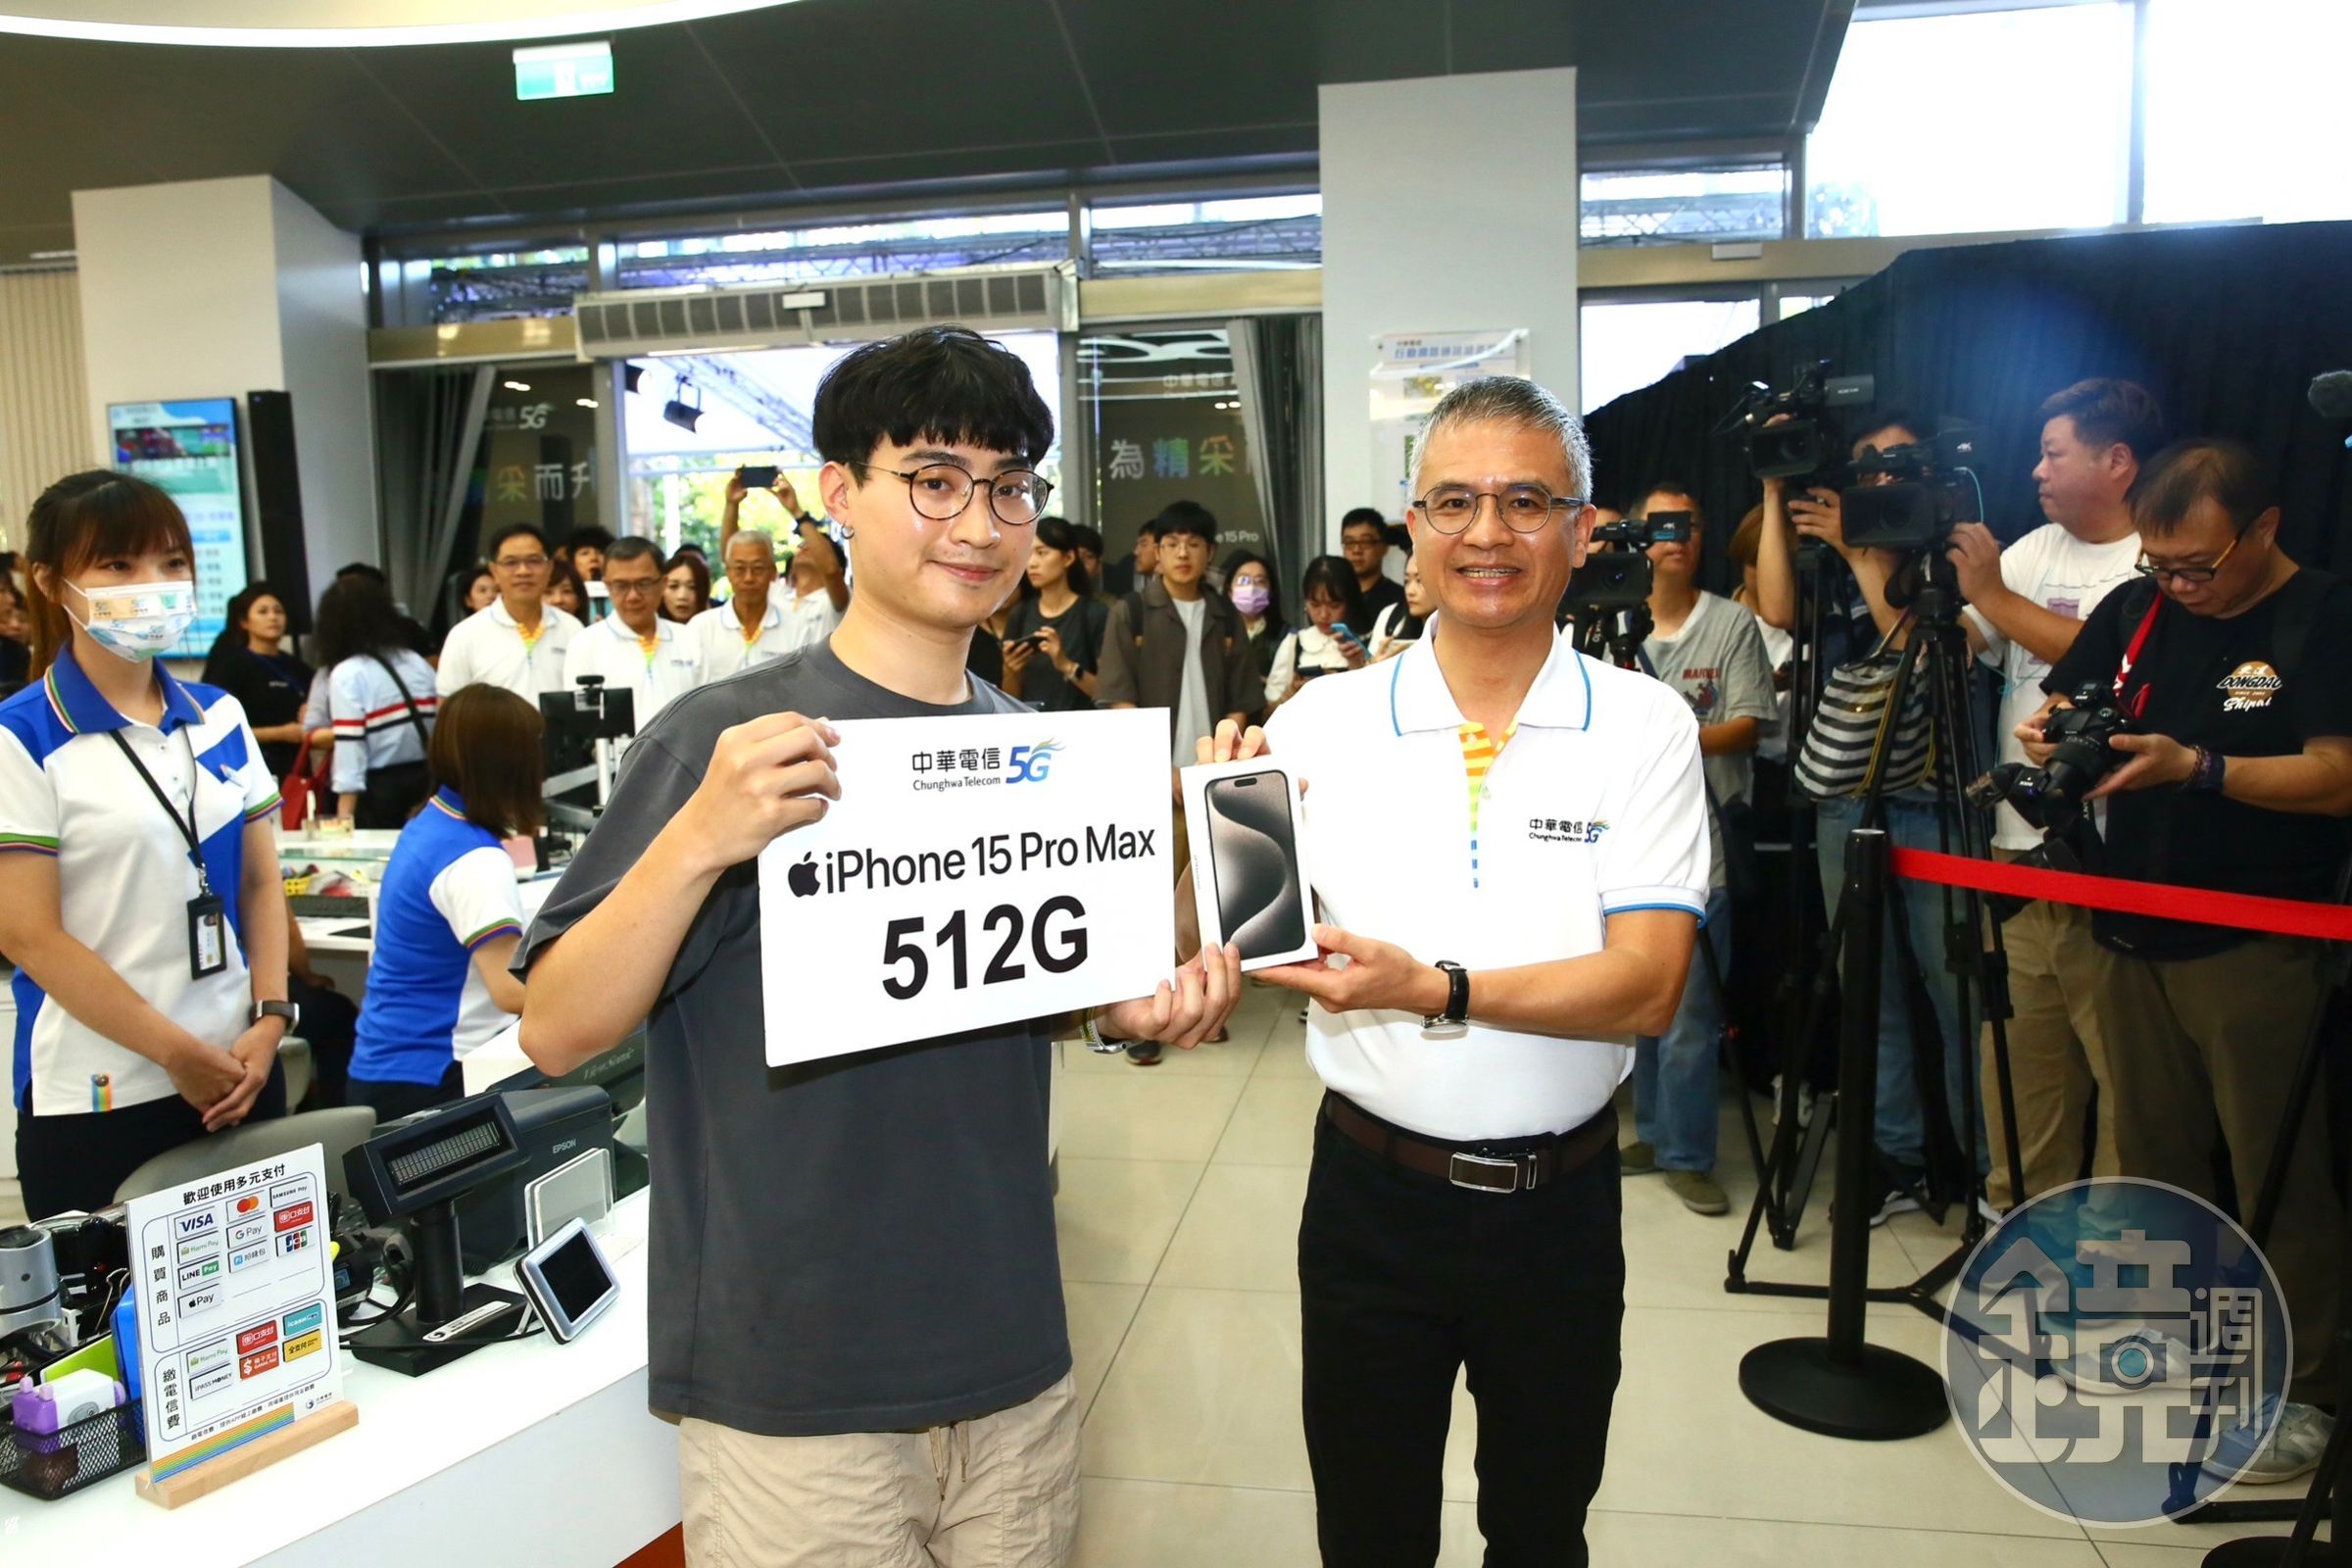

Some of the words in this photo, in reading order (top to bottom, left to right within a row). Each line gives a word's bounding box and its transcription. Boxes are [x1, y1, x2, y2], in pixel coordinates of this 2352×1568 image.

[1109, 434, 1253, 479] 為精采
[1239, 530, 1259, 542] Pro
[911, 747, 1001, 774] 中華電信
[1005, 743, 1054, 784] 5G
[912, 778, 963, 793] Chunghwa
[964, 775, 1001, 787] Telecom
[1529, 818, 1583, 834] 中華電信
[826, 847, 965, 894] iPhone
[971, 834, 1012, 876] 15
[1020, 831, 1078, 871] Pro
[1086, 823, 1155, 863] Max
[882, 895, 1088, 1001] 512G
[552, 1139, 577, 1153] EPSON
[183, 1163, 286, 1205] 歡迎使用多元支付
[179, 1213, 214, 1232] VISA
[246, 1225, 263, 1237] Pay
[286, 1230, 308, 1252] JCB
[181, 1268, 201, 1282] LINE
[203, 1262, 219, 1274] Pay
[151, 1245, 171, 1326] 購買商品
[196, 1293, 215, 1306] Pay
[163, 1367, 180, 1430] 繳電信費
